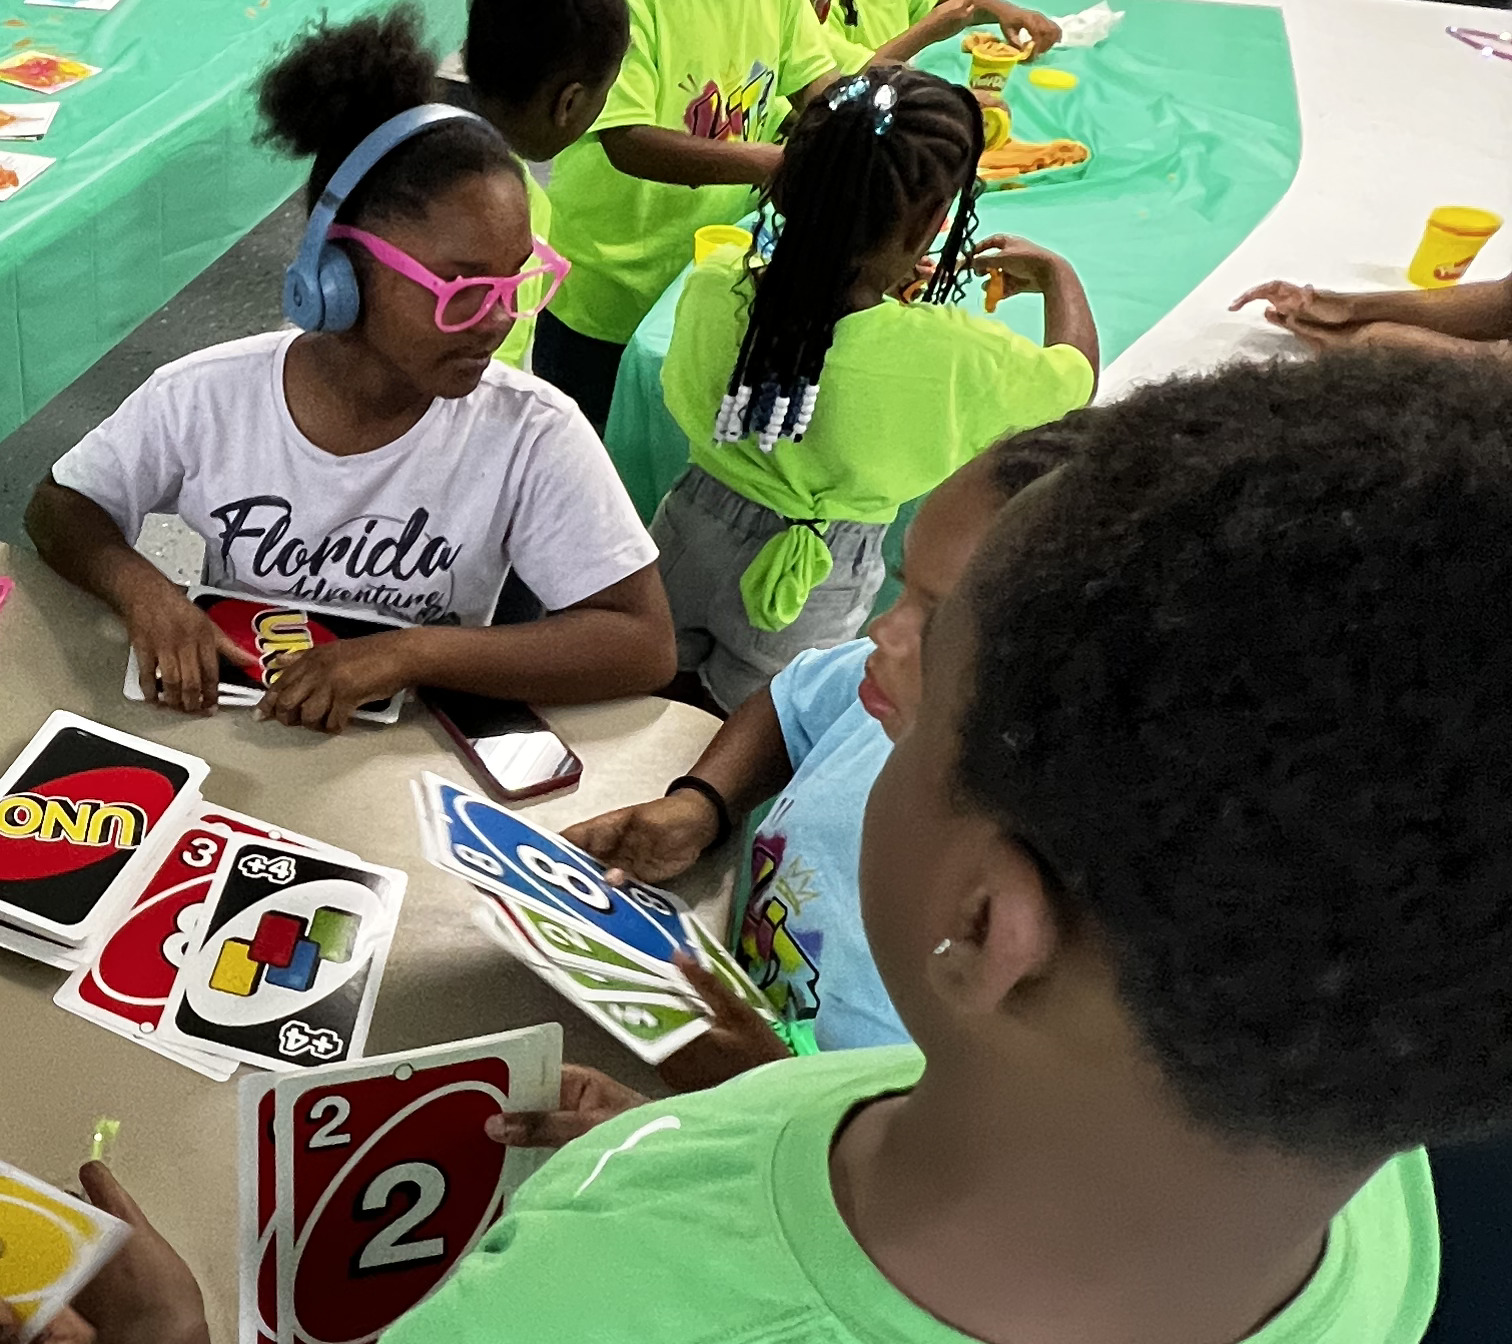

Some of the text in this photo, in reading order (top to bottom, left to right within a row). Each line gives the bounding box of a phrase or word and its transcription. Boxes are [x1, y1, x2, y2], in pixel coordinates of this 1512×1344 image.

[210, 494, 464, 582] Florida
[181, 836, 219, 868] 3
[239, 855, 296, 884] +4
[516, 843, 611, 911] 8
[279, 1021, 343, 1058] +4
[308, 1094, 352, 1149] 2
[356, 1160, 447, 1271] 2
